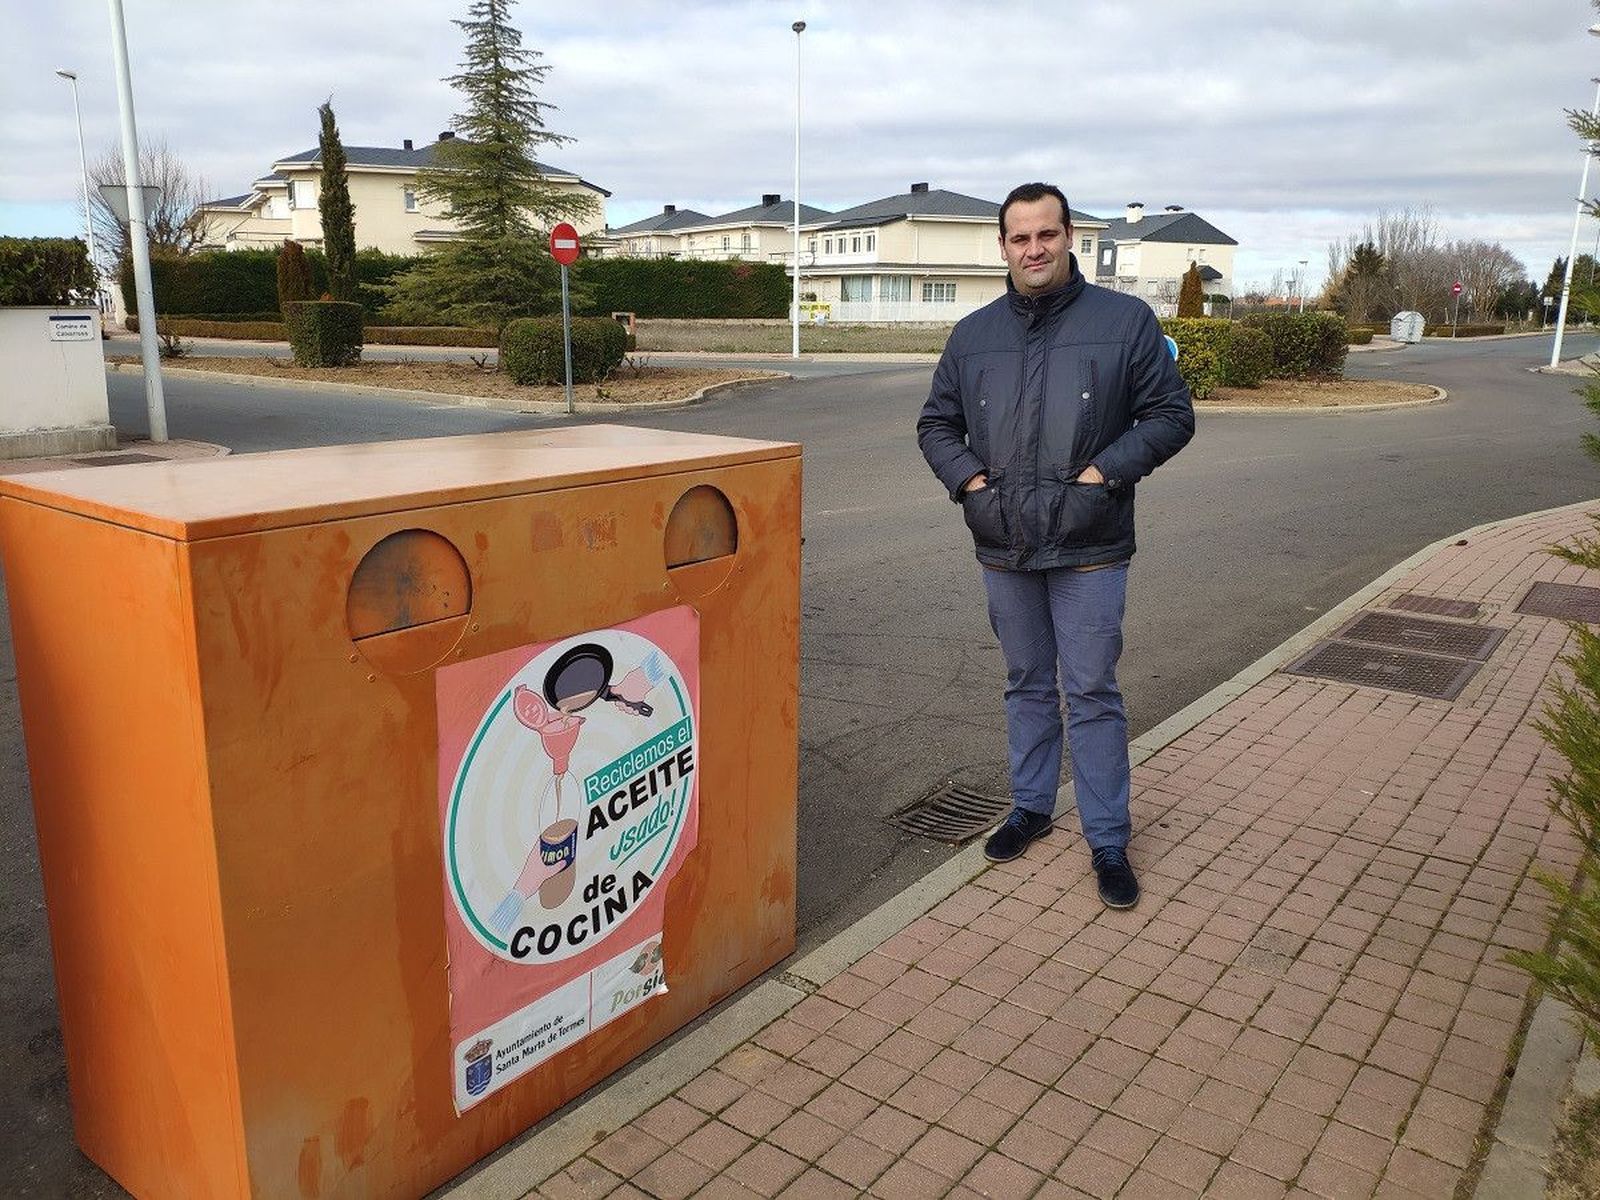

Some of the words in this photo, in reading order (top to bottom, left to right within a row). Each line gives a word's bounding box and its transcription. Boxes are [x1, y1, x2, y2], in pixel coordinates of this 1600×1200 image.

[586, 746, 694, 840] ACEITE
[587, 734, 674, 800] Reciclemos
[678, 720, 691, 743] el
[510, 870, 653, 959] COCINA
[583, 874, 616, 903] de
[495, 1022, 552, 1060] Ayuntamiento
[552, 1015, 564, 1026] de
[495, 1055, 520, 1075] Santa
[522, 1038, 547, 1059] Marta
[547, 1032, 558, 1044] de
[558, 1016, 585, 1038] Tormes
